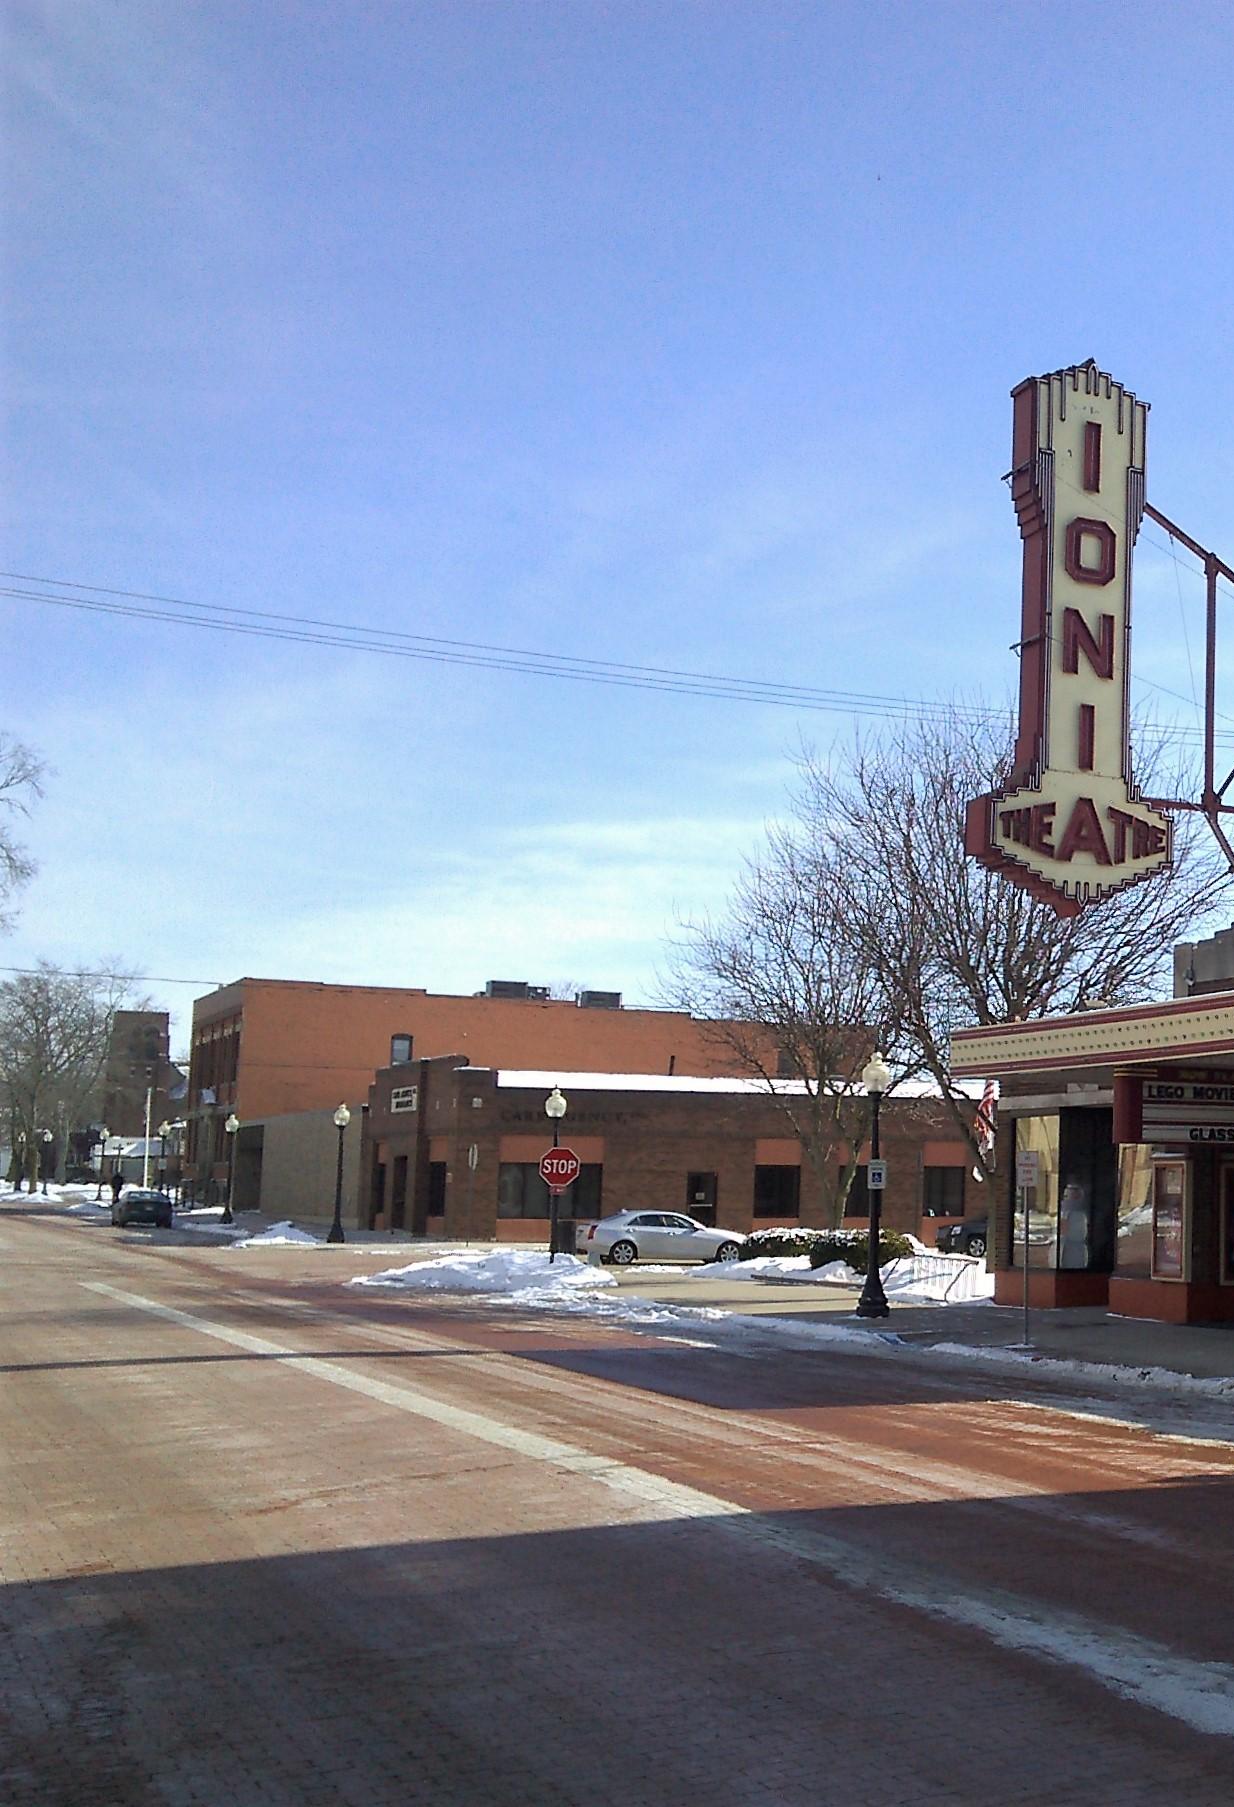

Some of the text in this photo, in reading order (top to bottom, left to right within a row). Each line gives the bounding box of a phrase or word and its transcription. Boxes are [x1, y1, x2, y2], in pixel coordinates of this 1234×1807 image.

[999, 797, 1167, 866] THEATRE
[1147, 1085, 1185, 1099] LEGO
[542, 1159, 578, 1174] STOP
